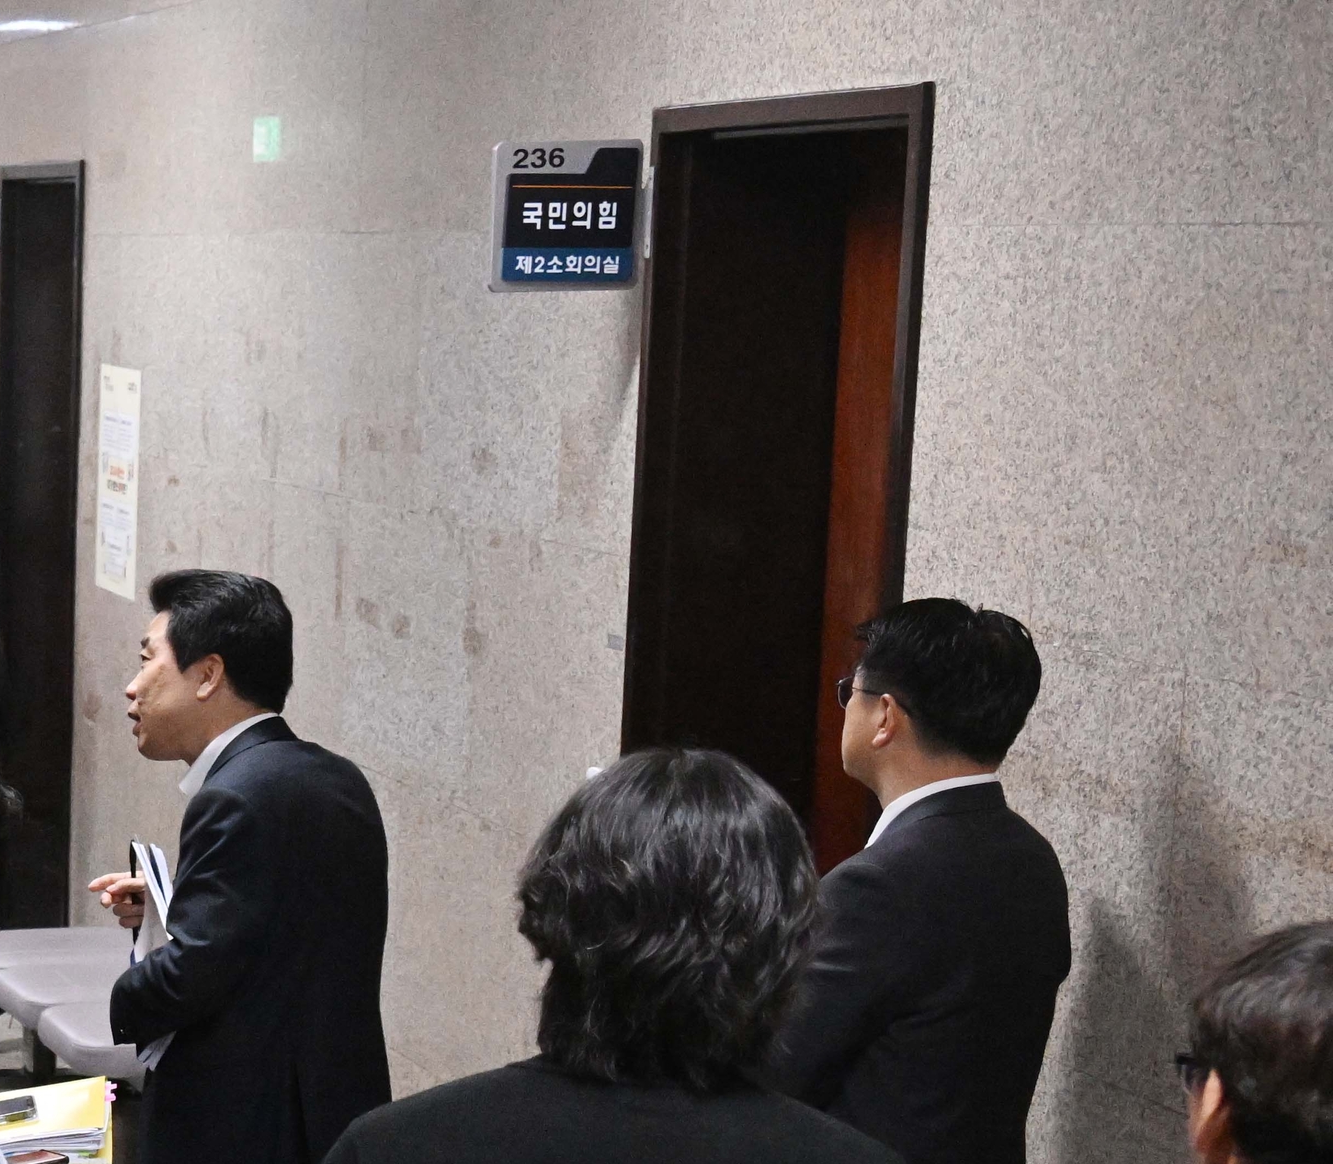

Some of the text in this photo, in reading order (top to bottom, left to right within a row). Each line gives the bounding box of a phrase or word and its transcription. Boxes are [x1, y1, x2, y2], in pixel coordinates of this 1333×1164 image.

[512, 147, 565, 169] 236
[522, 201, 618, 230] 국민의힘
[514, 255, 620, 274] 제2소회의실
